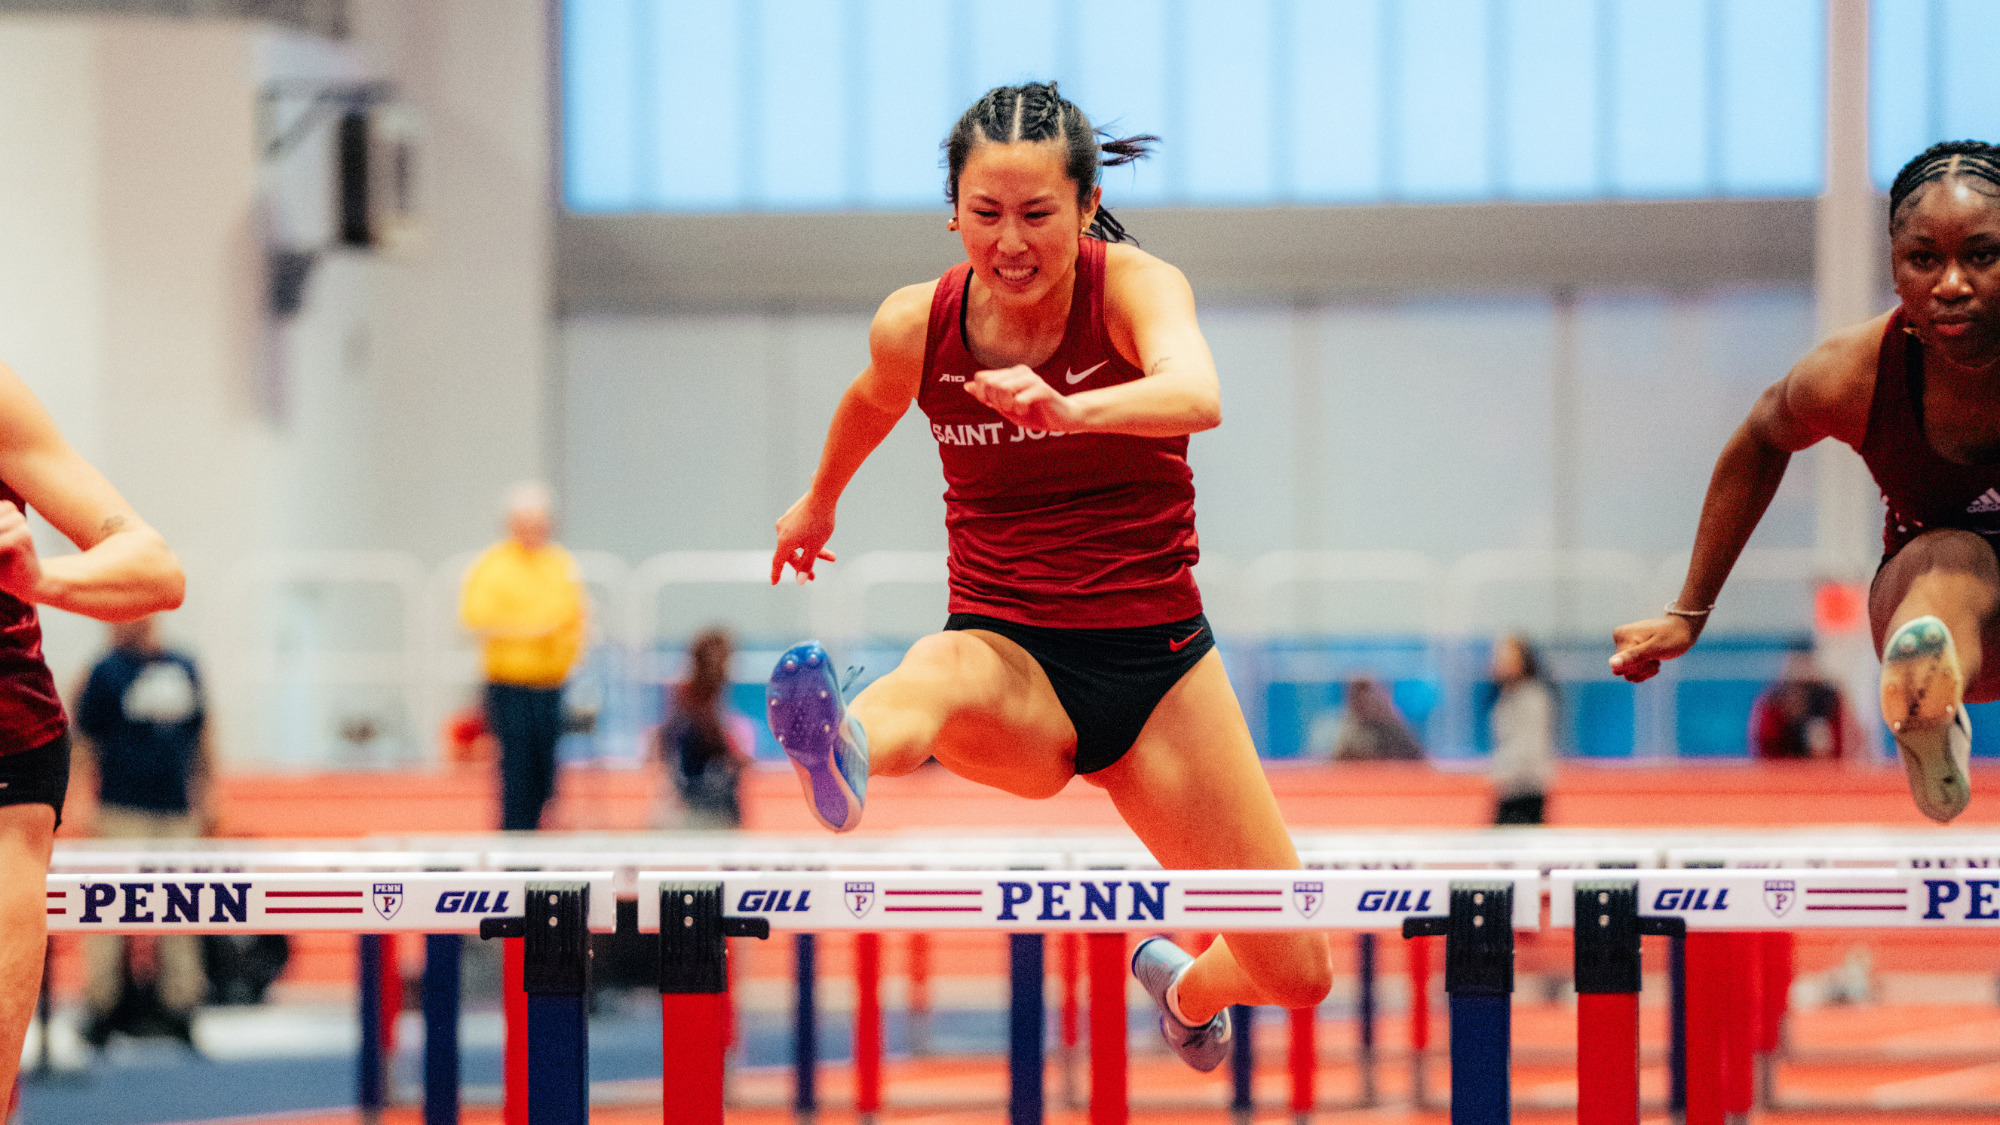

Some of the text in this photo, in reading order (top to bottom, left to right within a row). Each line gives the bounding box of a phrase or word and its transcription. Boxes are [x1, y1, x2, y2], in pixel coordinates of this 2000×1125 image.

[932, 421, 1065, 446] SAINT JO
[374, 884, 401, 893] PENN
[1653, 888, 1729, 910] GILL
[79, 882, 252, 923] PENN
[435, 890, 510, 914] GILL
[737, 889, 812, 912] GILL
[855, 895, 867, 911] P
[996, 881, 1171, 921] PENN
[1357, 890, 1431, 912] GILL
